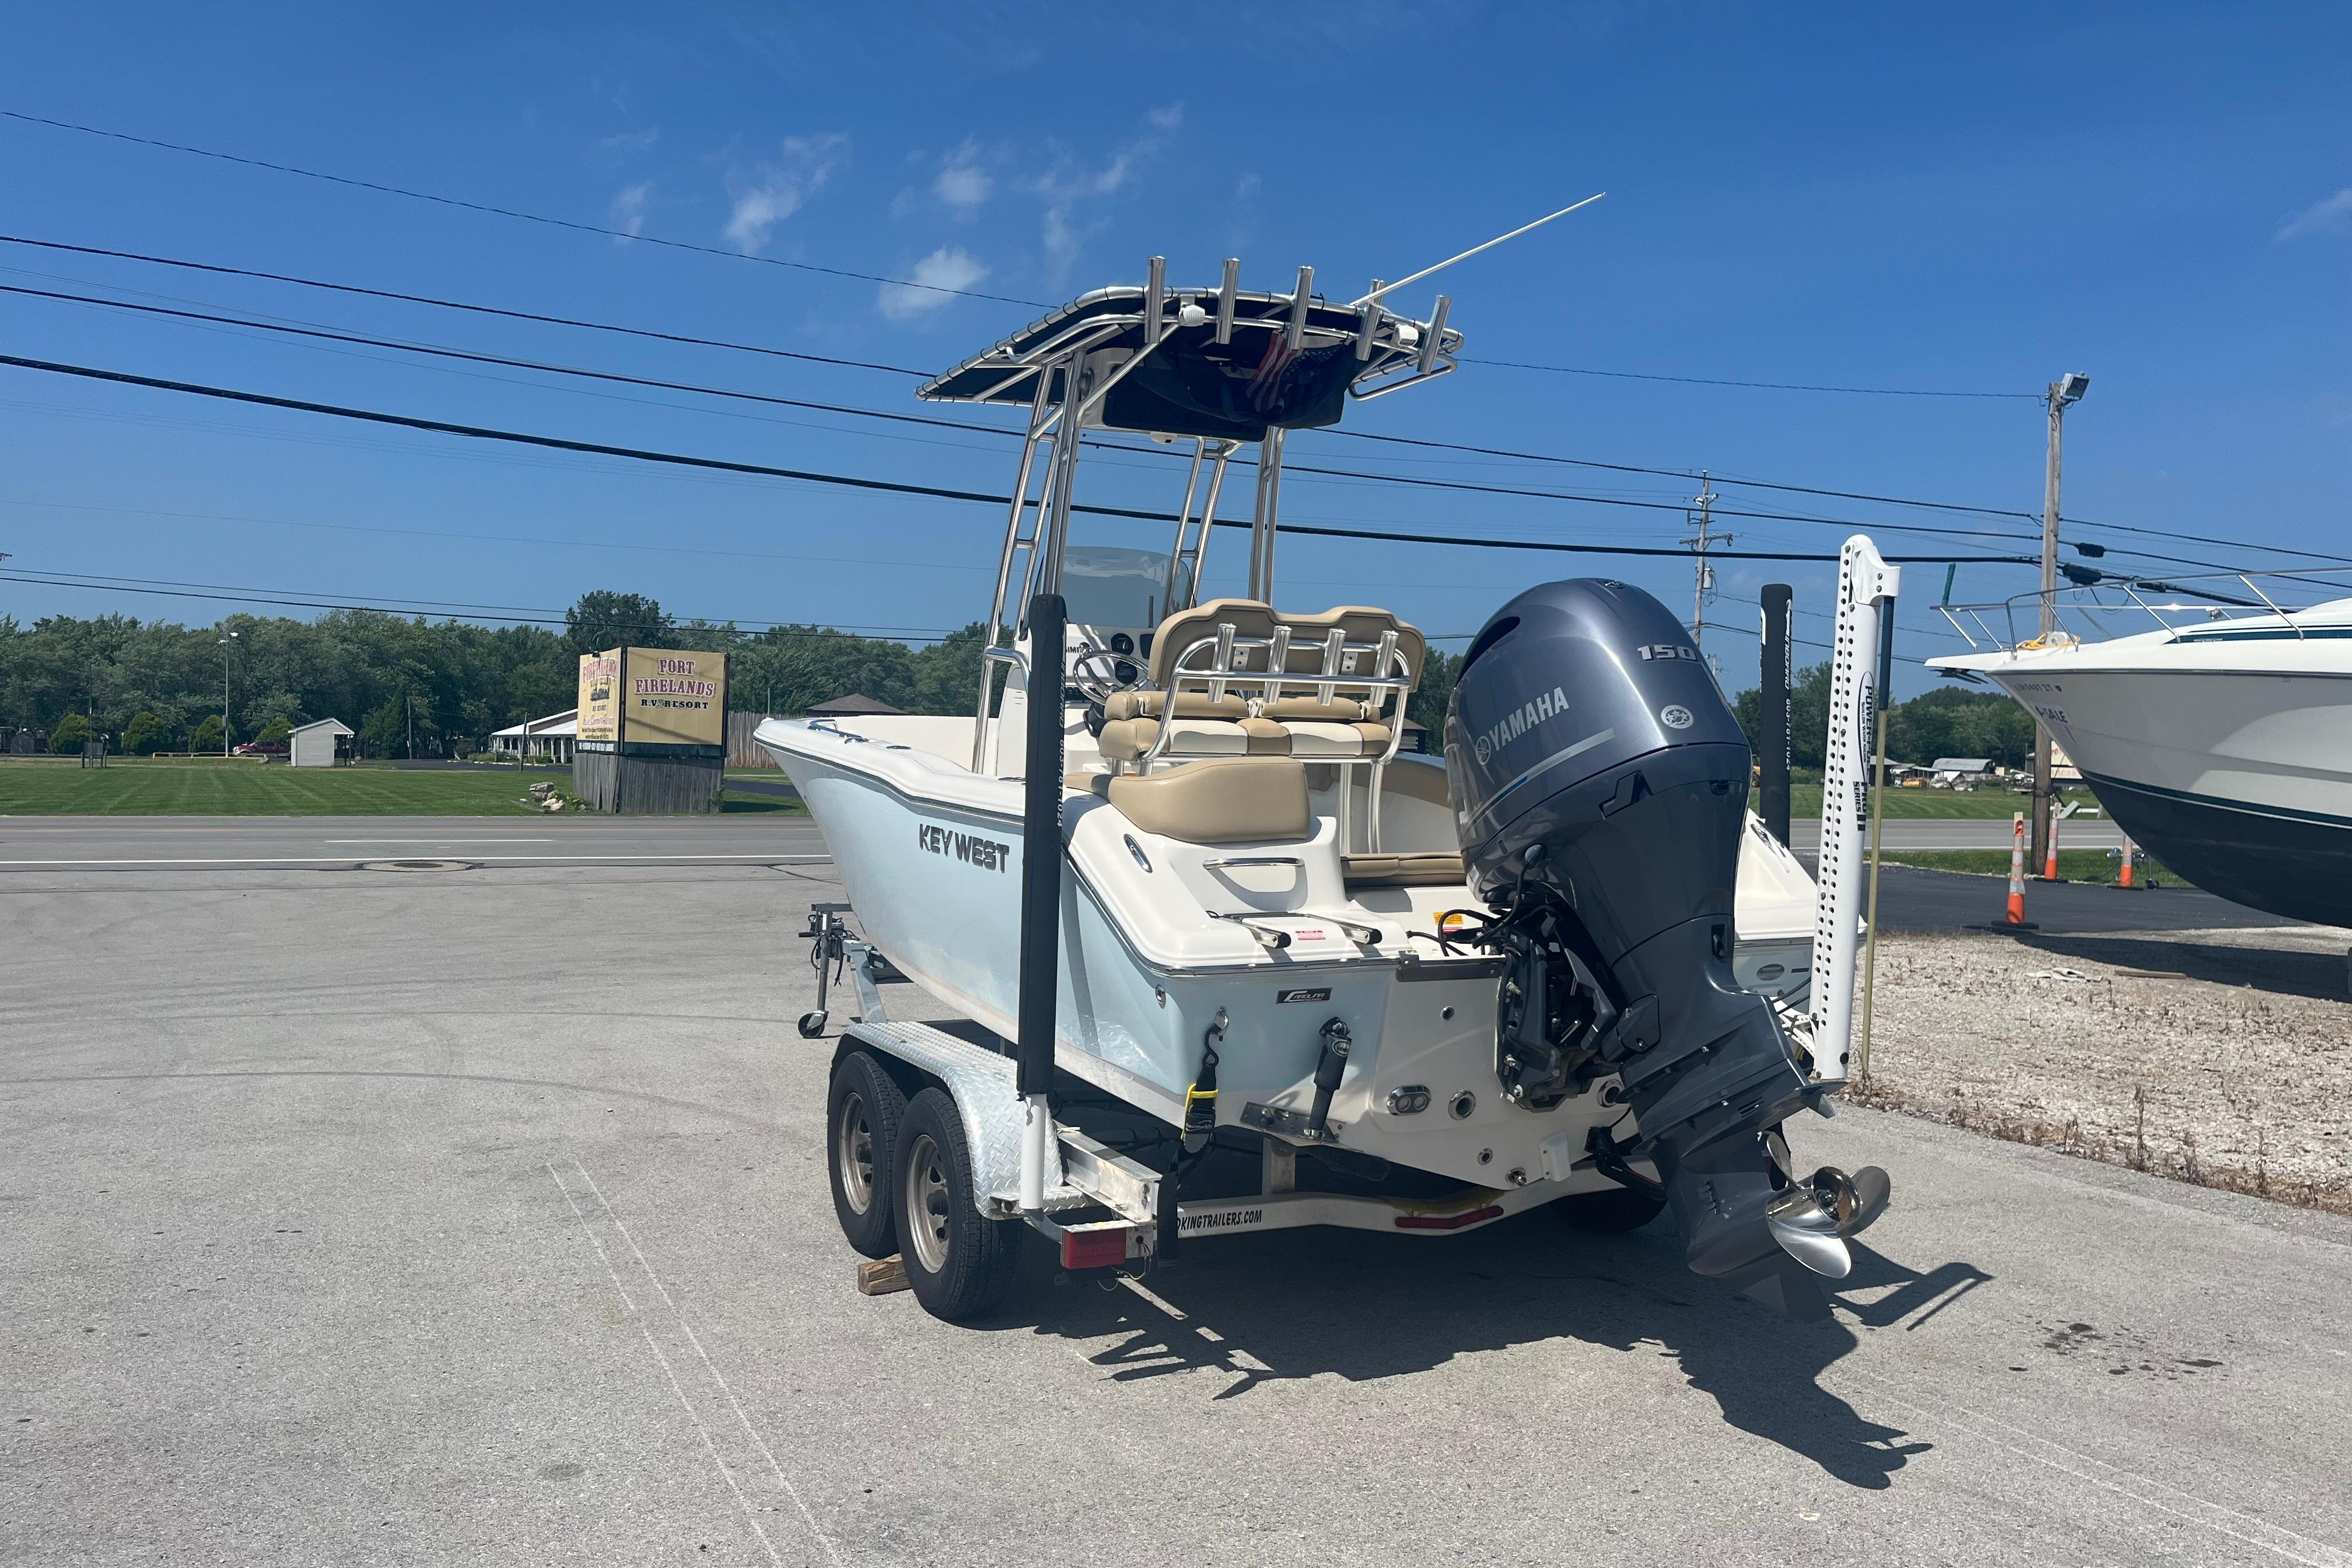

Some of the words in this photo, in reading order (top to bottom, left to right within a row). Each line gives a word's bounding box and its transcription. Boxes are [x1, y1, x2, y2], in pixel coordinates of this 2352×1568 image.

[1637, 645, 1696, 661] 150
[659, 659, 695, 674] FORT
[635, 678, 715, 696] FIRELANDS
[641, 699, 660, 707] R.V.
[664, 700, 709, 709] RESORT
[1489, 687, 1570, 752] YAMAHA
[1853, 781, 1861, 812] SERIES
[919, 824, 953, 857] KEY
[954, 832, 1010, 874] WEST
